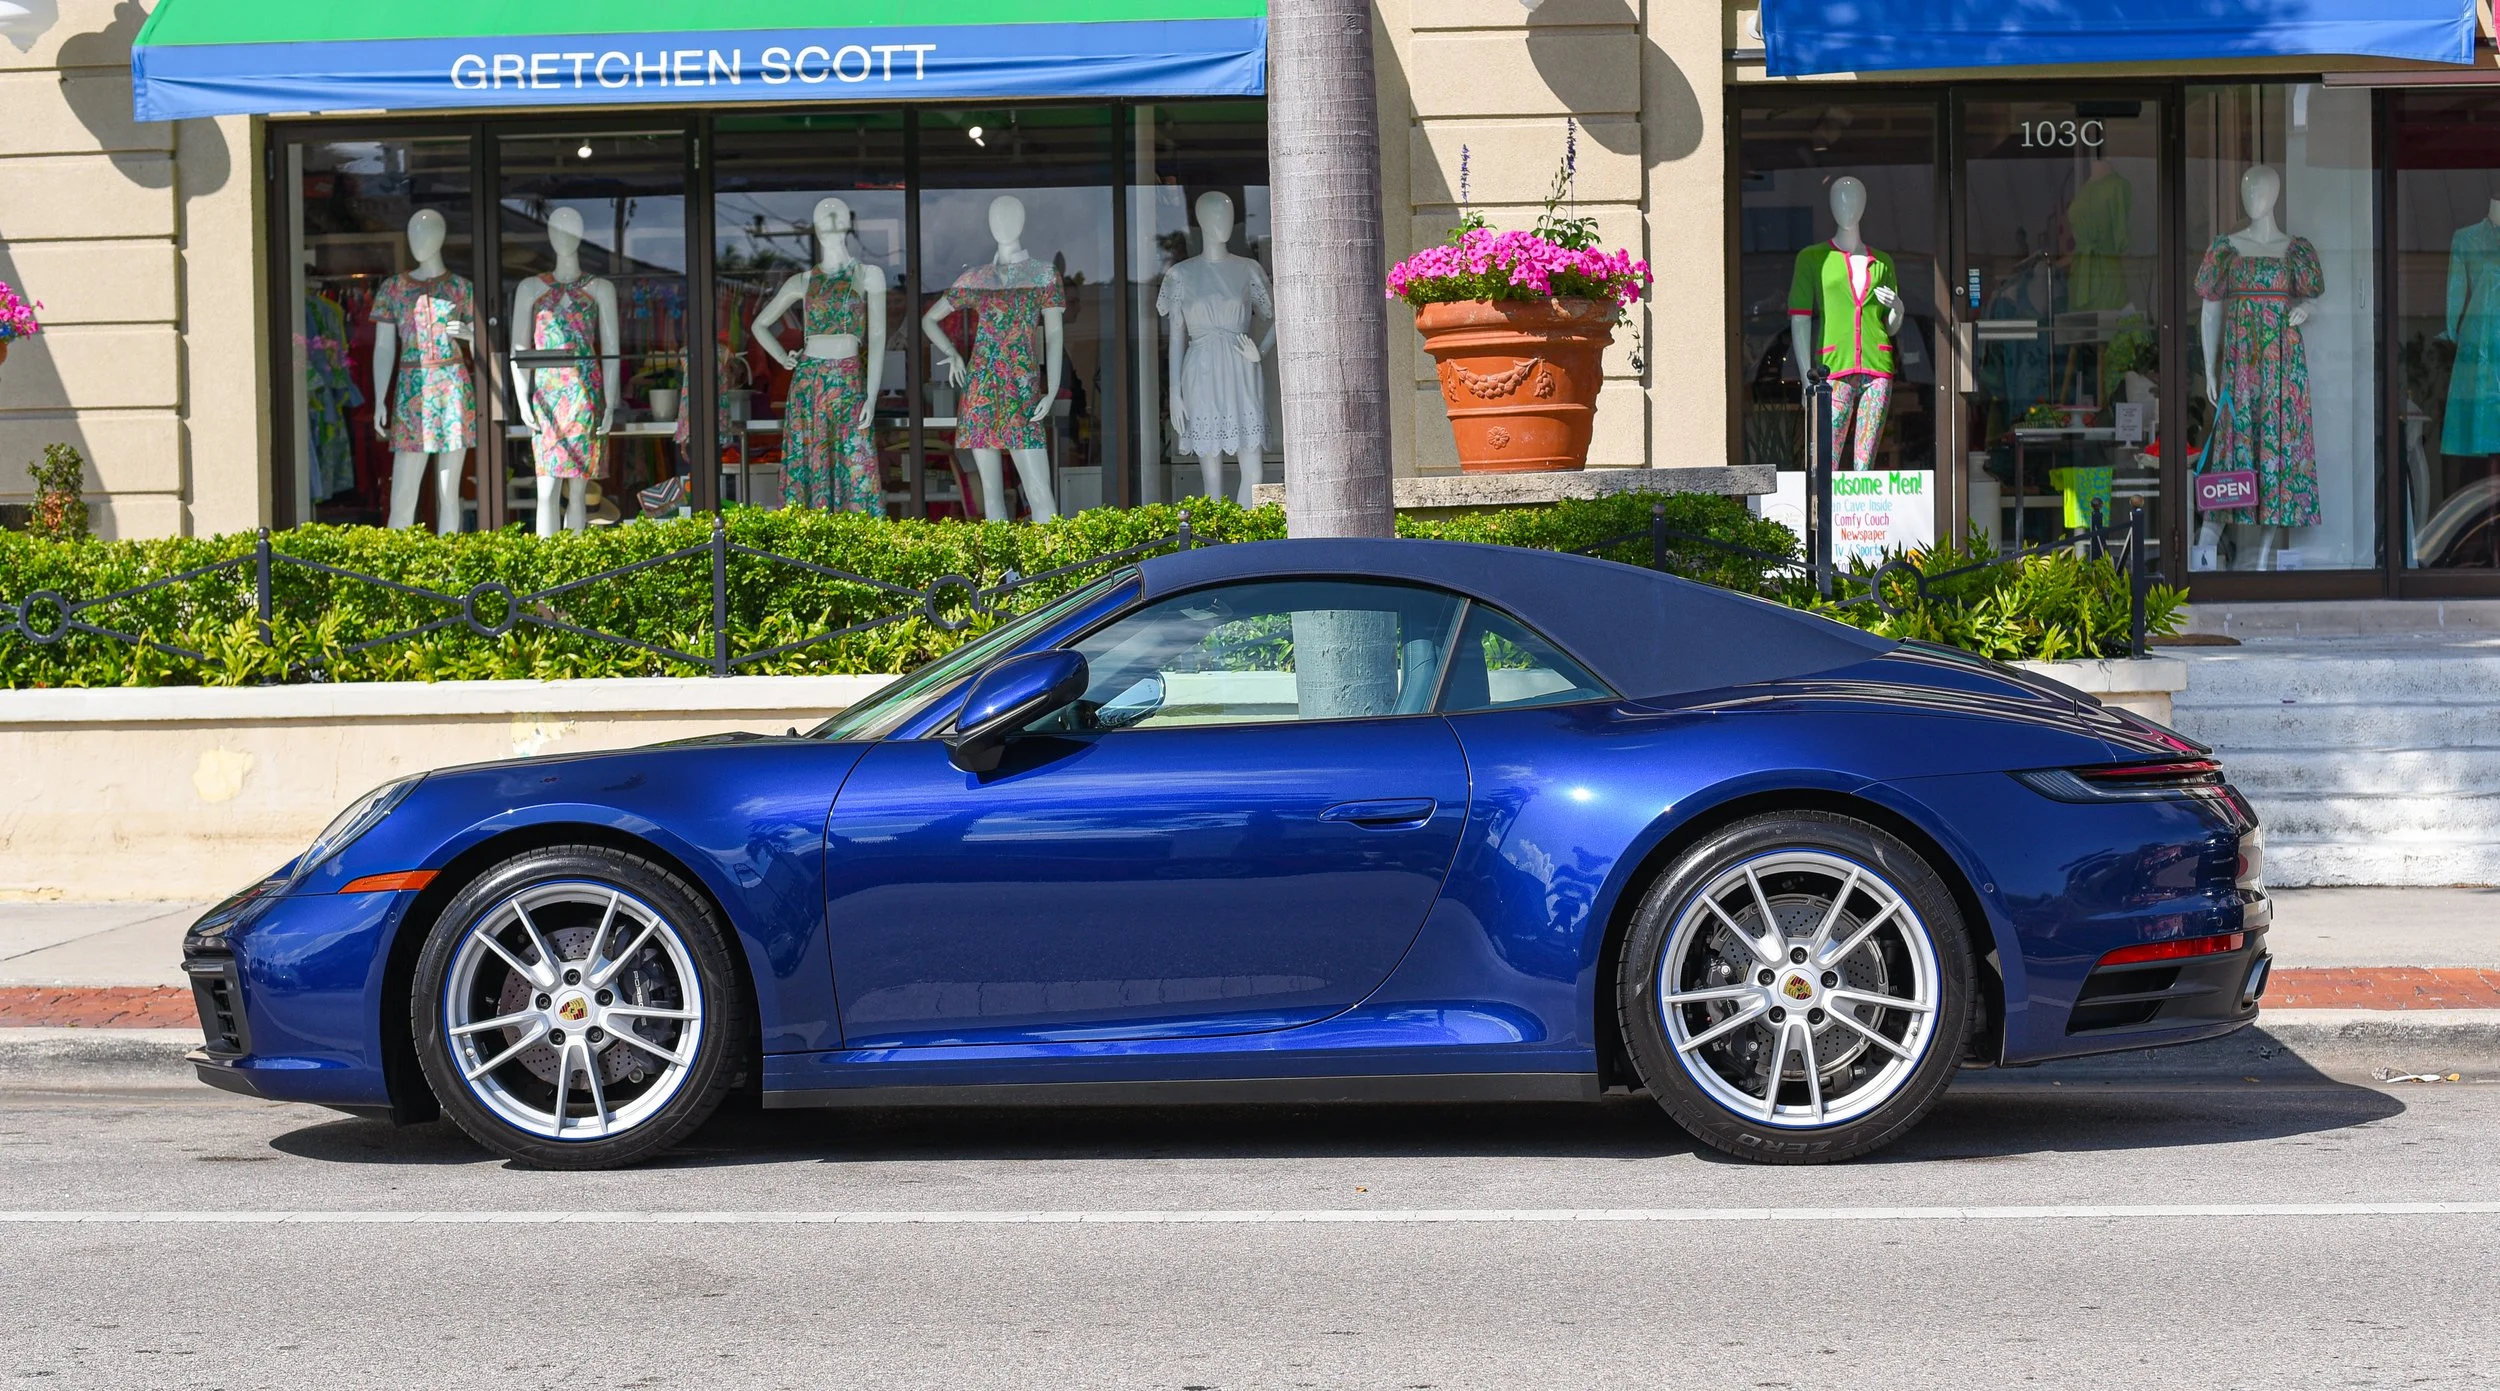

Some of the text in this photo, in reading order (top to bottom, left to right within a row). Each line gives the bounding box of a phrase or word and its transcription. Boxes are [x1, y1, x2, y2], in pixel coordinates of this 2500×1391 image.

[450, 43, 937, 90] GRETCHEN SCOTT
[2020, 120, 2104, 147] 103C
[1832, 471, 1922, 496] ndsome Men!
[2203, 481, 2251, 499] OPEN
[1844, 499, 1866, 512] Cave
[1869, 498, 1893, 511] Inside
[1834, 512, 1890, 528] Comfy Couch
[1841, 528, 1886, 543] Newspaper
[1735, 1133, 1832, 1155] ZERO
